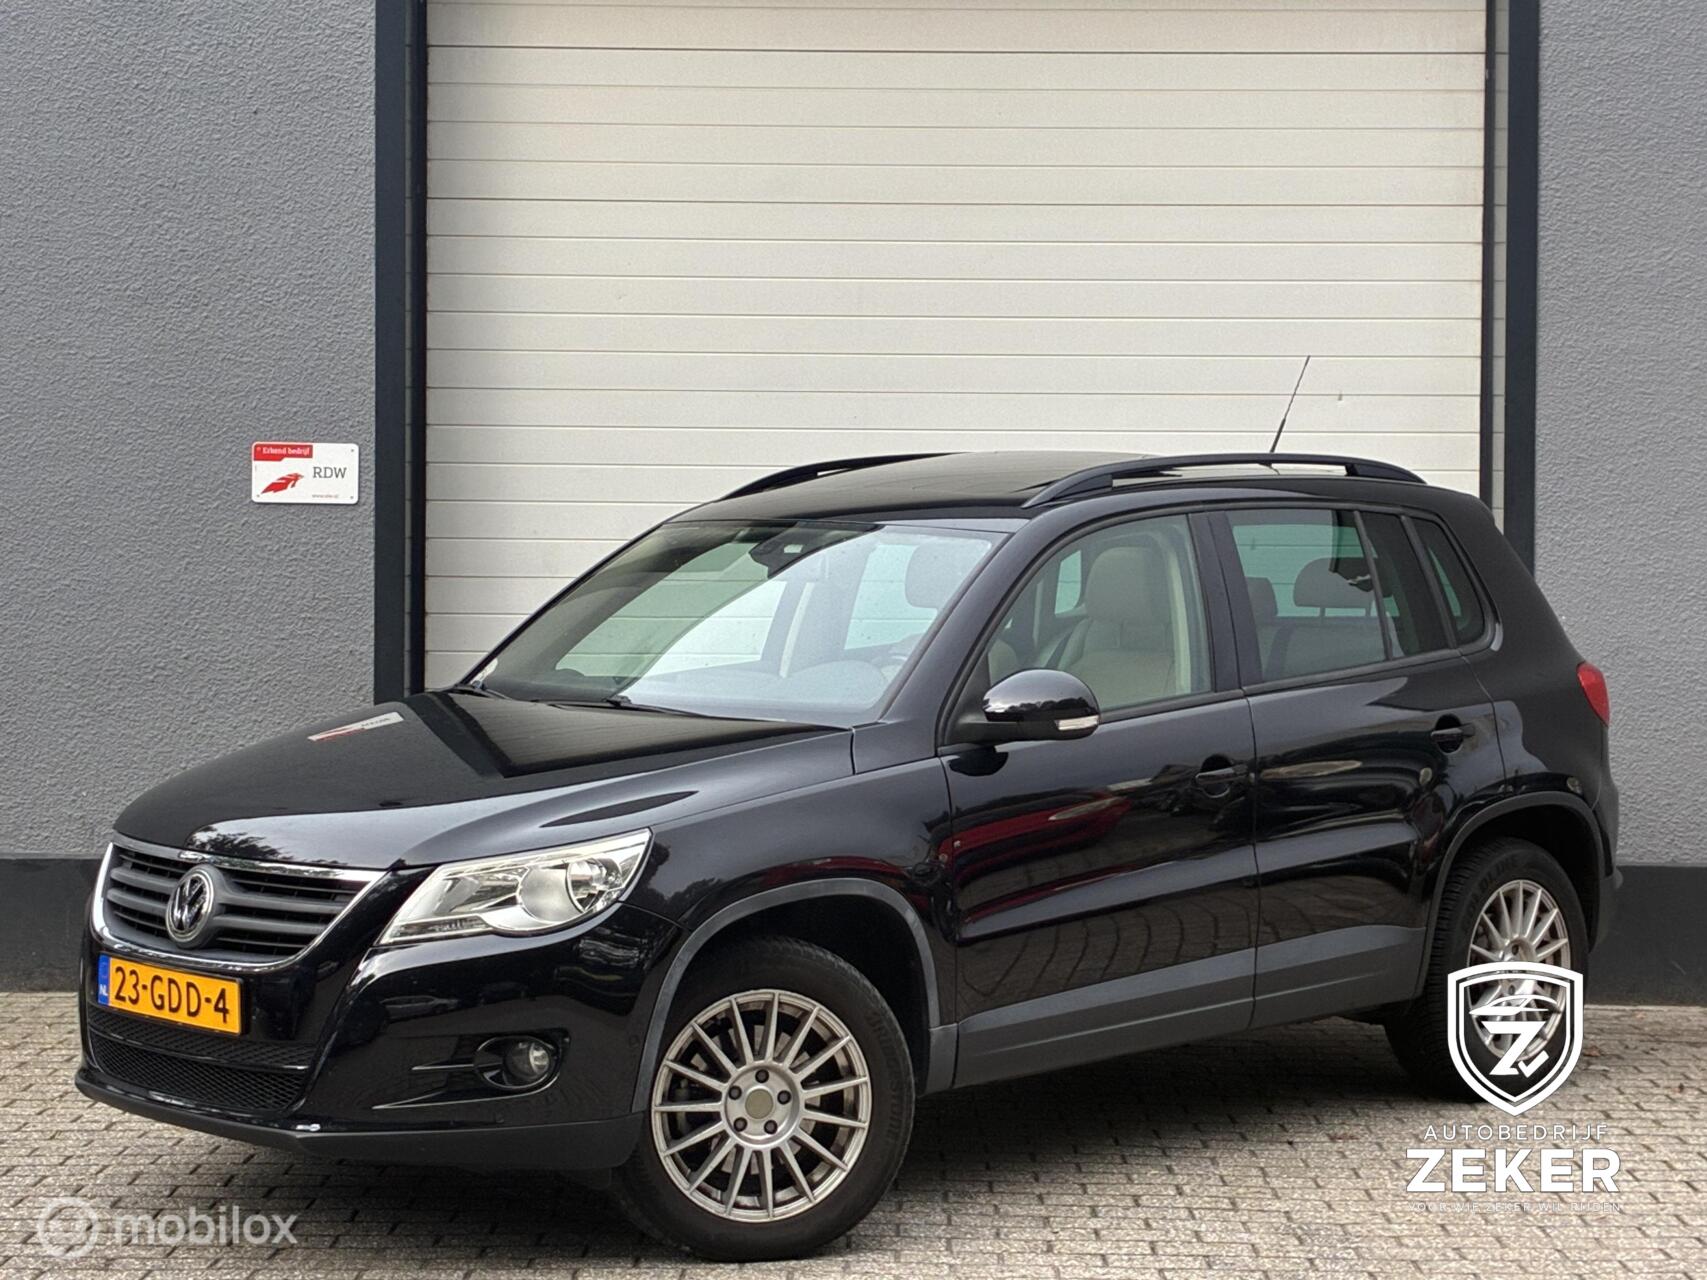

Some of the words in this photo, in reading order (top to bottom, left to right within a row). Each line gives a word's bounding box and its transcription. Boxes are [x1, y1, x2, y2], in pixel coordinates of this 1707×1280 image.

[262, 446, 287, 455] Erkend
[287, 447, 310, 456] bedrijf
[312, 466, 347, 479] RDW
[99, 983, 108, 996] NL
[114, 966, 229, 1024] 23-GDD-4
